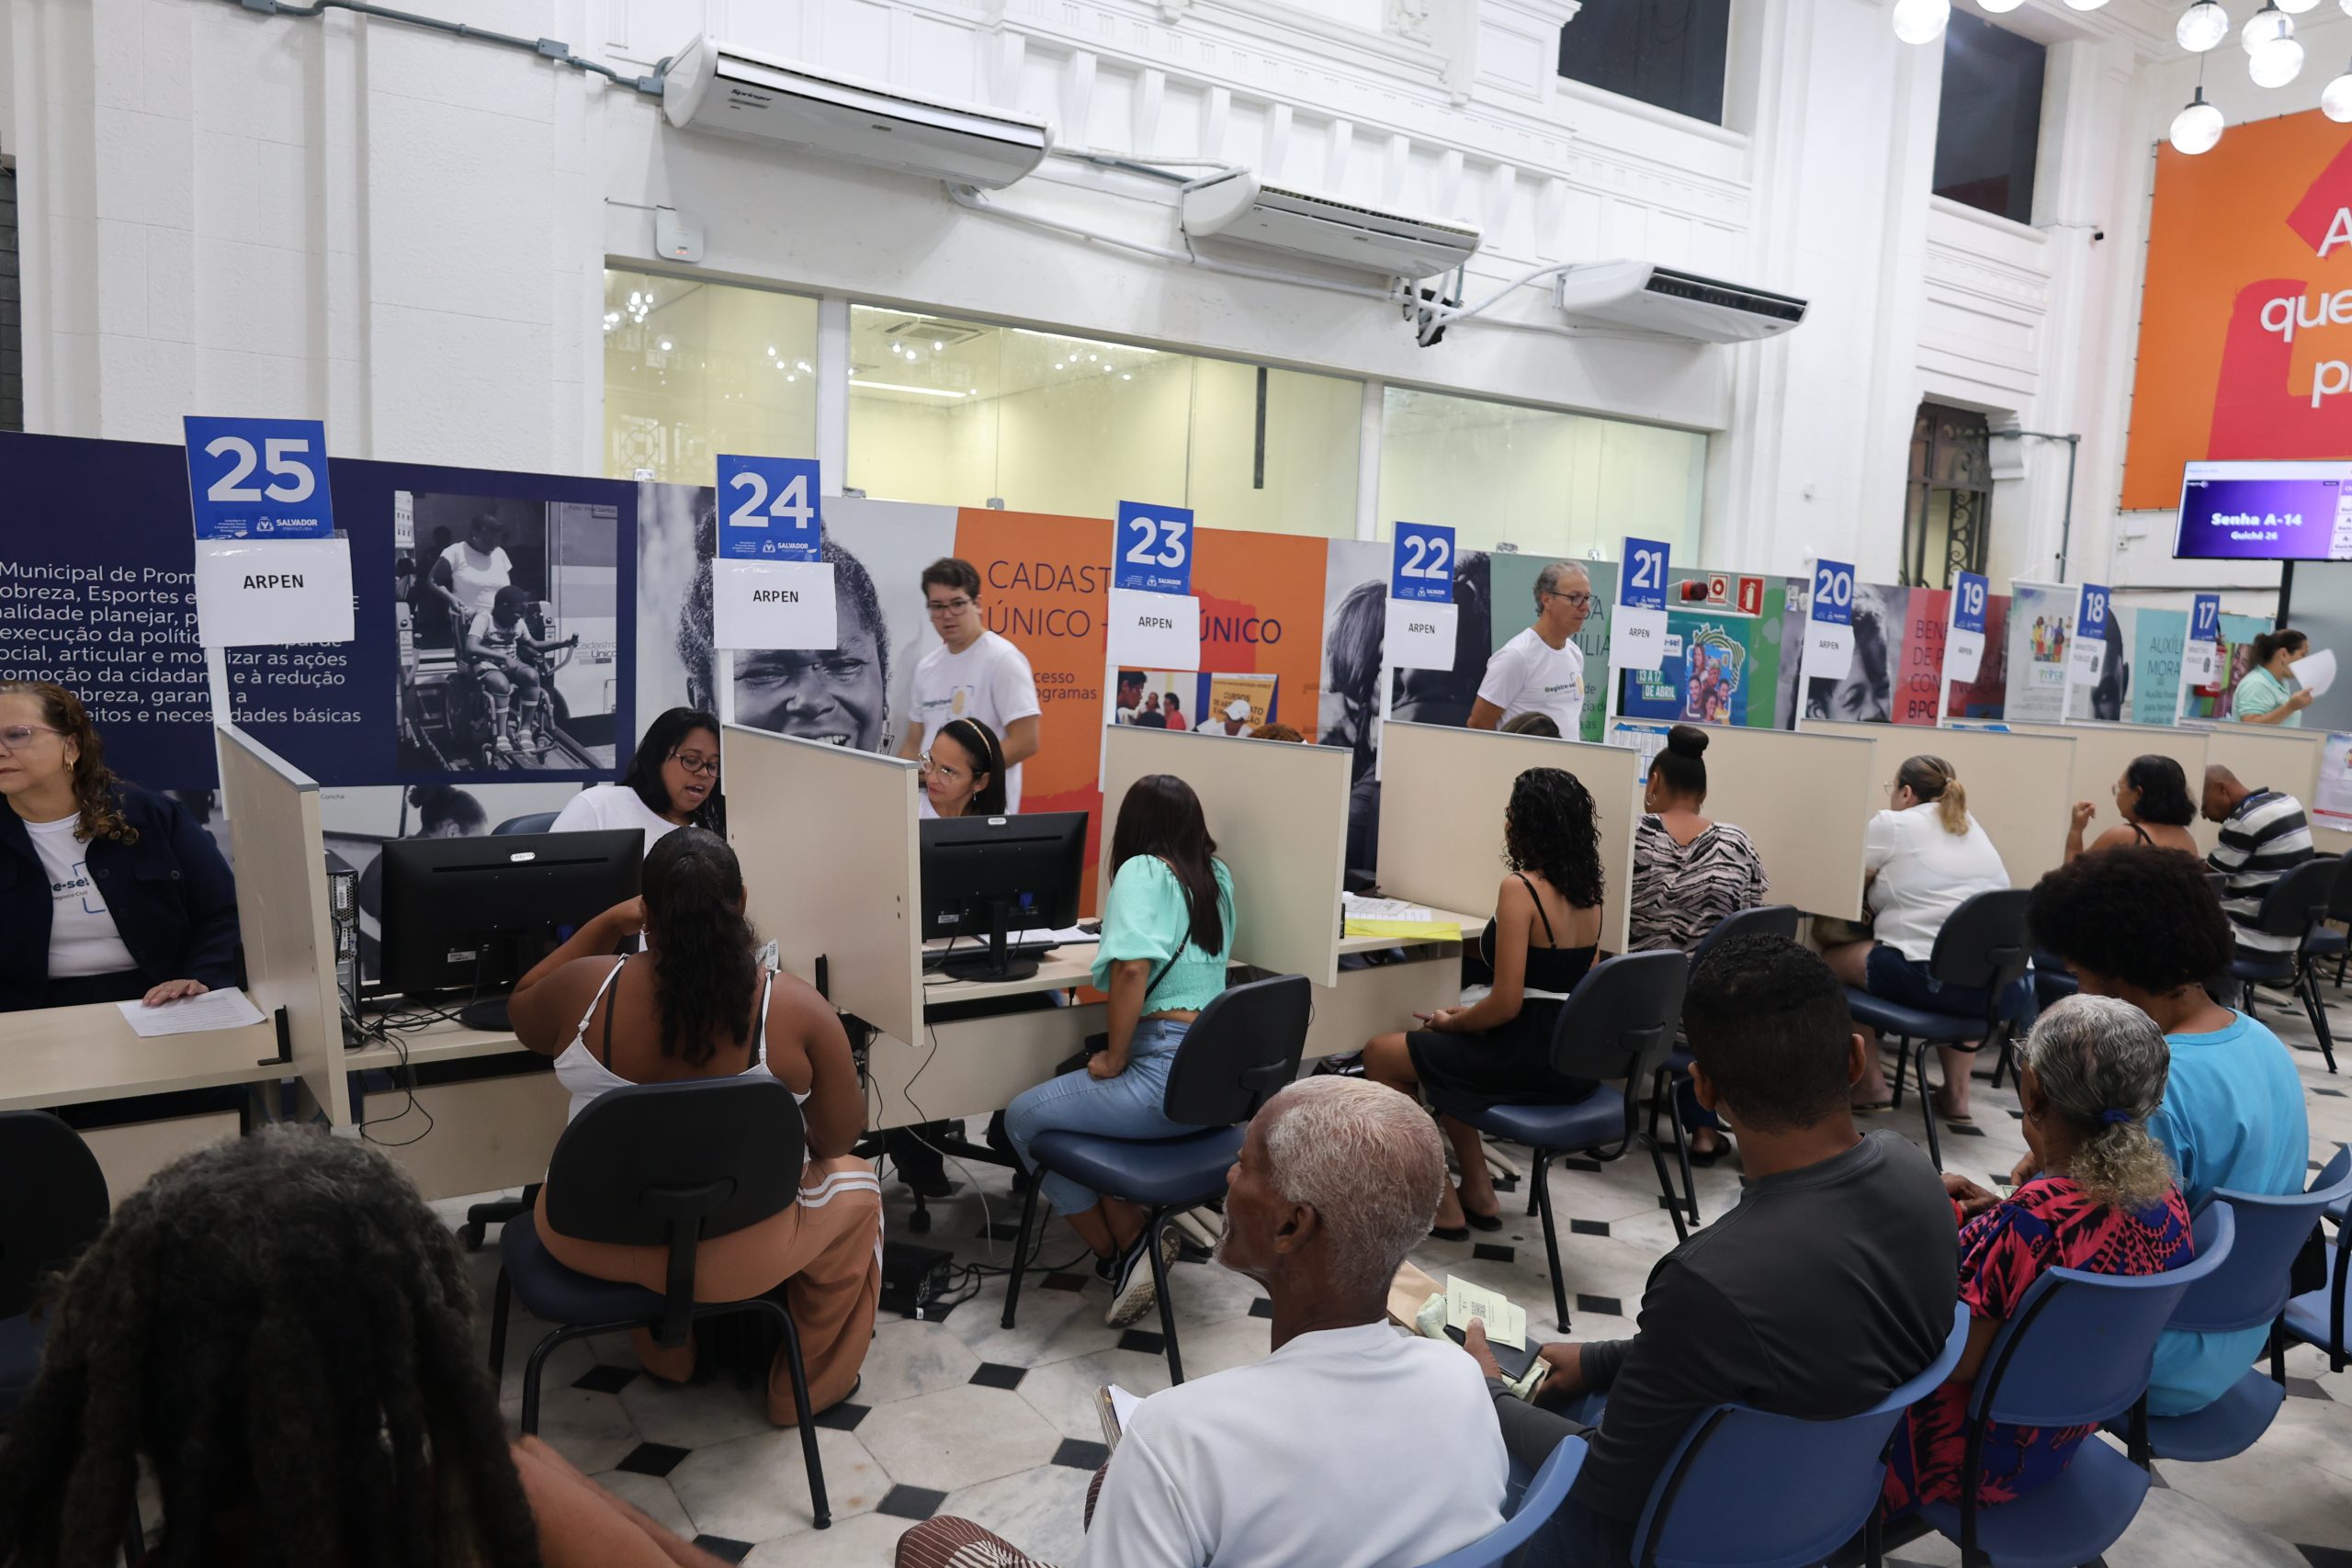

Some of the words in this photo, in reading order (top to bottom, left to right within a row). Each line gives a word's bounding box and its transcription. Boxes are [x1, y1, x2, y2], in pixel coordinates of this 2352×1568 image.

[204, 436, 315, 503] 25
[729, 472, 814, 529] 24
[2211, 513, 2260, 526] Senha
[2264, 513, 2302, 526] A-14
[1126, 516, 1186, 568] 23
[2231, 531, 2263, 540] Guichê
[1401, 535, 1449, 580] 22
[0, 561, 103, 583] Municipal
[110, 566, 136, 581] de
[143, 568, 196, 585] Prom
[989, 560, 1112, 593] CADAST
[1631, 549, 1662, 589] 21
[243, 574, 304, 589] ARPEN
[1815, 569, 1851, 606] 20
[0, 582, 81, 603] obreza,
[89, 586, 179, 605] Esportes
[753, 590, 798, 603] ARPEN
[1963, 581, 1984, 615] 19
[0, 604, 84, 621] alidade
[91, 606, 178, 626] planejar,
[2086, 592, 2105, 623] 18
[2199, 602, 2216, 629] 17
[989, 599, 1090, 637] ÚNICO
[1138, 616, 1172, 629] ARPEN
[1200, 609, 1281, 644] ÚNICO
[0, 626, 102, 644] execução
[108, 627, 134, 642] da
[141, 627, 201, 646] polític
[1408, 623, 1435, 634] ARPEN
[1629, 627, 1650, 638] ARPEN
[1819, 640, 1839, 649] ARPEN
[2150, 634, 2184, 654] AUXÍLI
[0, 645, 52, 663] ocial,
[59, 647, 146, 662] articular
[152, 651, 164, 663] e
[267, 654, 288, 665] as
[293, 652, 347, 669] ações
[1913, 647, 1931, 666] DE
[0, 667, 92, 685] omoção
[97, 667, 124, 682] da
[233, 672, 245, 683] e
[251, 670, 262, 683] à
[268, 670, 345, 688] redução
[1034, 672, 1075, 683] cesso
[1639, 671, 1645, 680] 13
[1648, 671, 1652, 680] A
[1654, 671, 1661, 681] 17
[2147, 660, 2179, 676] MORA
[70, 687, 144, 705] obreza,
[236, 692, 247, 703] a
[1036, 687, 1096, 702] ogramas
[1645, 685, 1654, 696] DE
[1656, 686, 1675, 698] ABRIL
[138, 710, 149, 722] e
[293, 707, 361, 723] básicas
[1908, 700, 1937, 718] BPC
